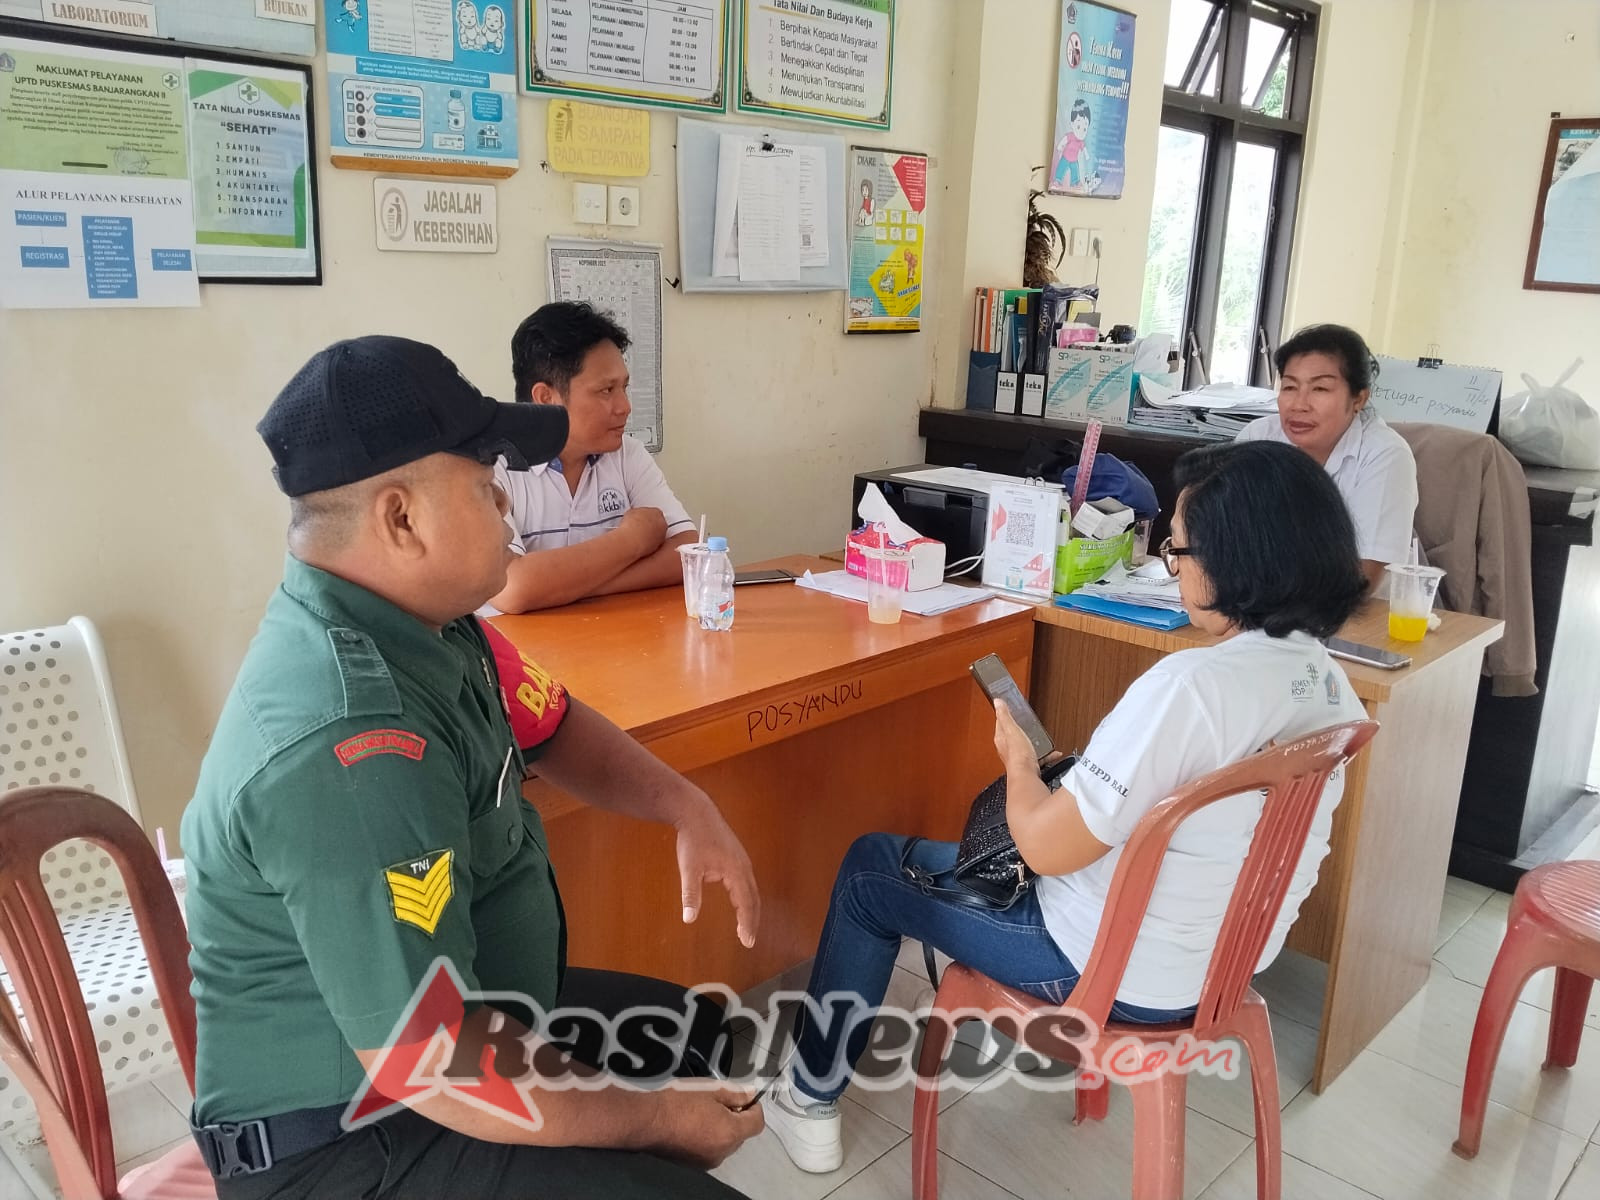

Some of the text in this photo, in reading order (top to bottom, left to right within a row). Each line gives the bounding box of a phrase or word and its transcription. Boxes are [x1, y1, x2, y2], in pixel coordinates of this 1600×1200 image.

[51, 3, 149, 28] LABORATORIUM
[264, 0, 308, 17] RUJUKAN
[790, 1, 809, 13] Nilai
[810, 5, 825, 17] Dan
[827, 9, 853, 25] Budaya
[855, 15, 873, 29] Kerja
[780, 20, 811, 35] Berpihak
[813, 28, 839, 42] Kepada
[840, 33, 878, 49] Masyarakat
[780, 36, 812, 51] Bertindak
[814, 43, 835, 59] Cepat
[836, 49, 849, 58] dan
[36, 64, 143, 84] MAKLUMAT PELAYANAN
[781, 52, 824, 71] Menegakkan
[825, 61, 865, 78] Kedisiplinan
[781, 68, 823, 86] Menunjukan
[14, 76, 37, 86] UPTD
[39, 79, 91, 92] PUSKESMAS
[93, 85, 159, 98] BANJARANGKAN
[780, 85, 824, 101] Mewujudkan
[193, 102, 301, 121] TATA NILAI PUSKESMAS
[578, 124, 642, 144] SAMPAH
[226, 142, 261, 152] SANTUN
[226, 155, 260, 165] EMPATI
[857, 155, 877, 167] DIARE
[226, 169, 267, 178] HUMANIS
[227, 182, 281, 192] AKUNTABEL
[16, 190, 183, 206] ALUR PELAYANAN KESEHATAN
[424, 189, 482, 215] JAGALAH
[17, 213, 65, 223] PASIEN/KLIEN
[228, 207, 284, 217] INFORMATIF
[413, 220, 493, 244] KEBERSIHAN
[25, 252, 65, 260] REGISTRASI
[516, 650, 552, 721] BA
[747, 679, 862, 743] POSYANDU
[1088, 762, 1111, 783] BPD
[410, 858, 430, 875] TNI
